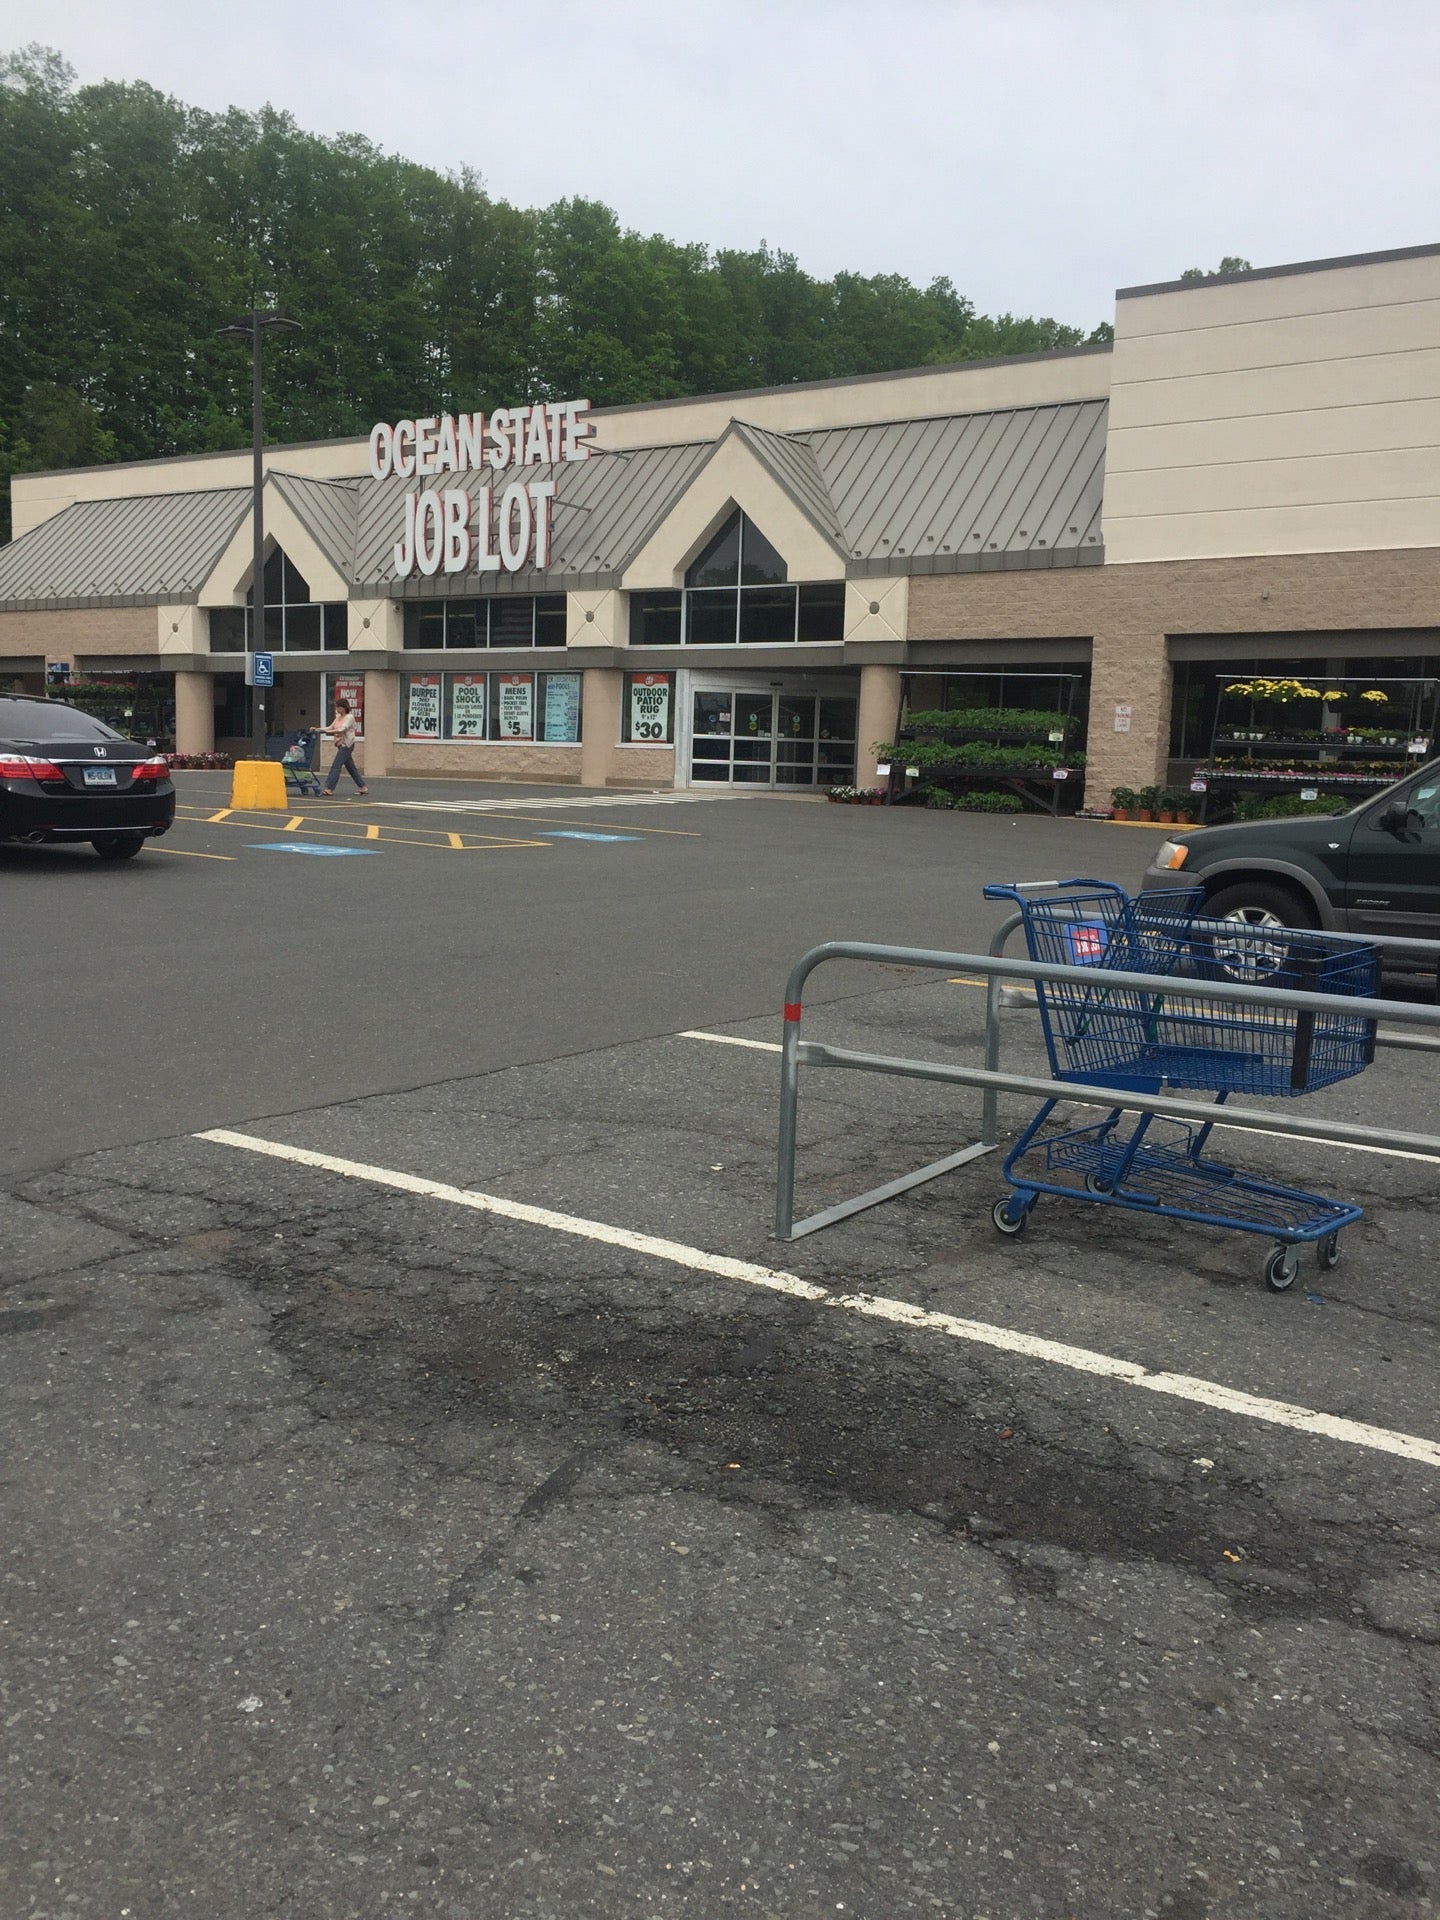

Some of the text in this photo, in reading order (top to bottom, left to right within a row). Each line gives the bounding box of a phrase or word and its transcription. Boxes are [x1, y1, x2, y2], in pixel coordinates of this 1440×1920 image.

[369, 399, 591, 480] OCEAN STATE
[394, 481, 558, 577] JOB LOT
[341, 689, 357, 697] NOW
[411, 688, 437, 698] BURPEE
[458, 687, 479, 695] POOL
[504, 687, 526, 695] MENS
[633, 688, 668, 697] OUTDOOR
[455, 695, 481, 703] SHOCK
[637, 696, 664, 705] PATIO
[640, 706, 660, 714] RUG
[507, 721, 521, 735] $5
[635, 721, 663, 739] $30
